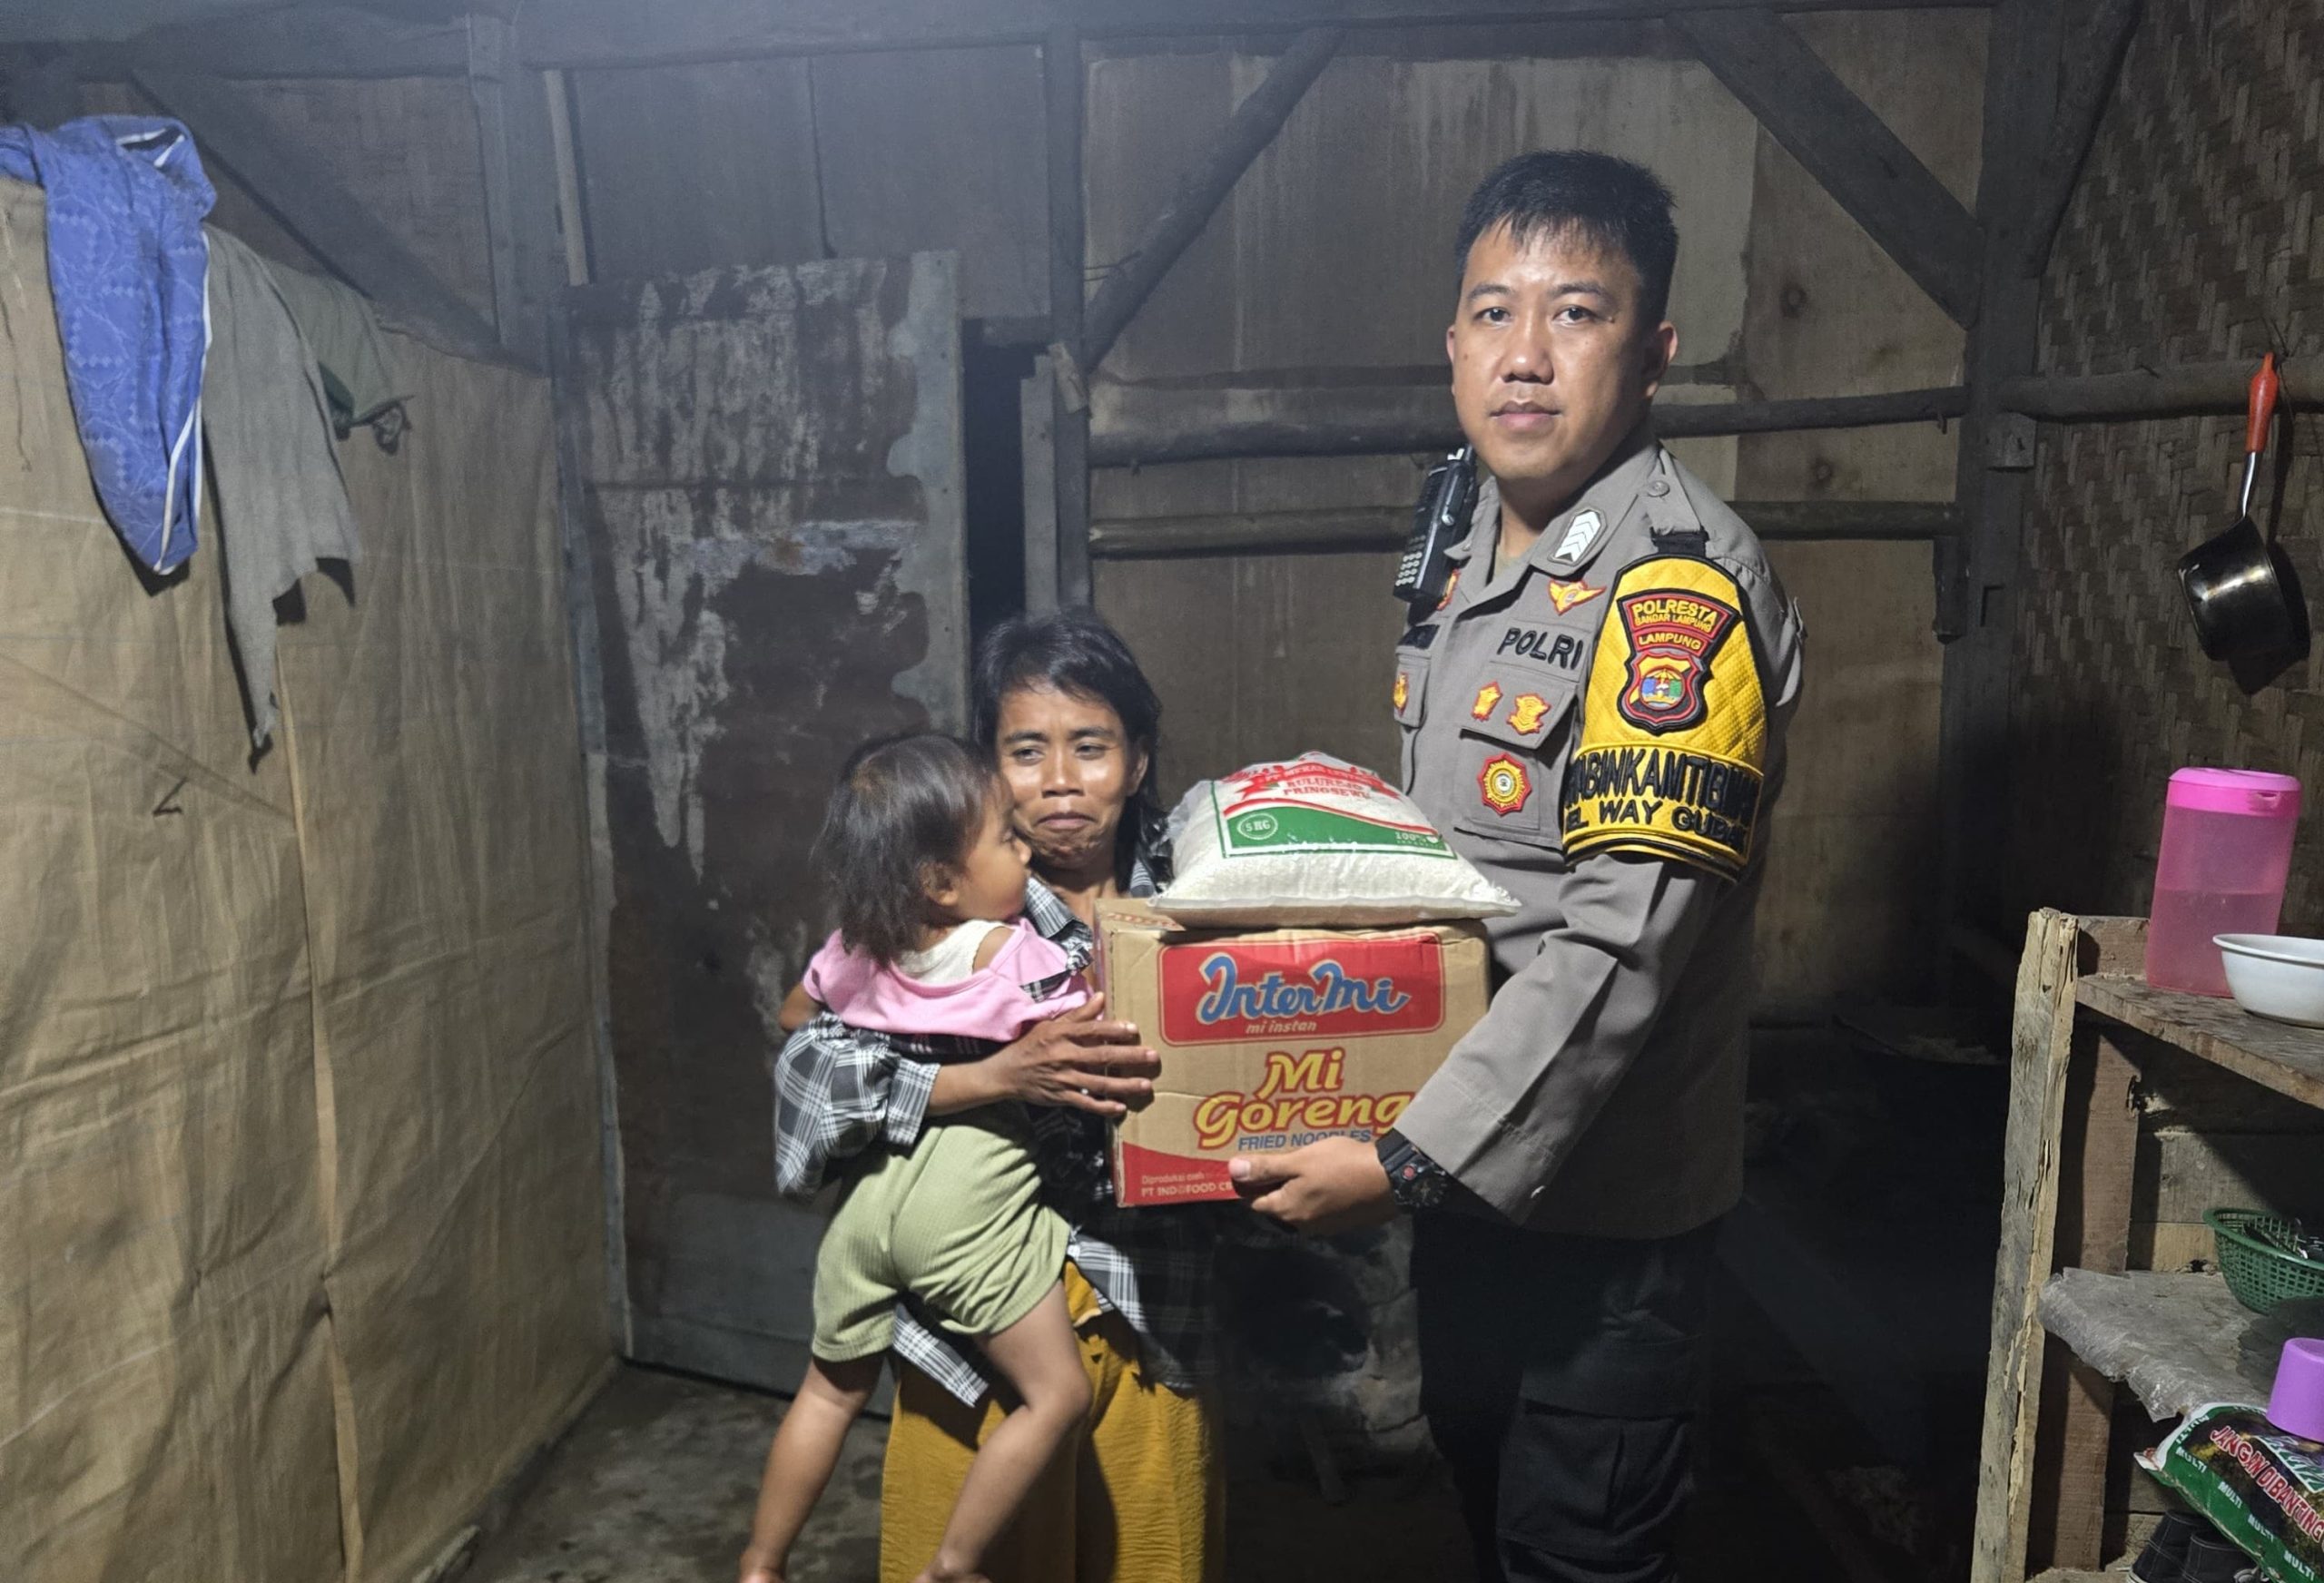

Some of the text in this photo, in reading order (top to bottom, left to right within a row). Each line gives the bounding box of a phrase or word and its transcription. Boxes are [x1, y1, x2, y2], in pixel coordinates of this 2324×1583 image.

[1631, 599, 1718, 626] POLRESTA
[1672, 613, 1712, 634] LAMPUNG
[1497, 626, 1585, 671] POLRI
[1638, 632, 1702, 650] LAMPUNG
[1599, 799, 1662, 825] WAY
[1246, 822, 1253, 832] 5
[1394, 831, 1427, 843] 100%
[1246, 1020, 1317, 1034] mi instan
[1256, 1047, 1345, 1100] Mi
[1193, 1091, 1415, 1149] Goreng
[1237, 1136, 1286, 1151] FRIED
[1141, 1187, 1154, 1197] PT
[2176, 1446, 2207, 1473] MULTI
[2210, 1425, 2271, 1479] JANGAN
[2255, 1466, 2324, 1543] DIBANTING
[2218, 1480, 2243, 1509] MULTI
[2248, 1514, 2274, 1541] MULTI
[2283, 1549, 2315, 1581] MULTI
